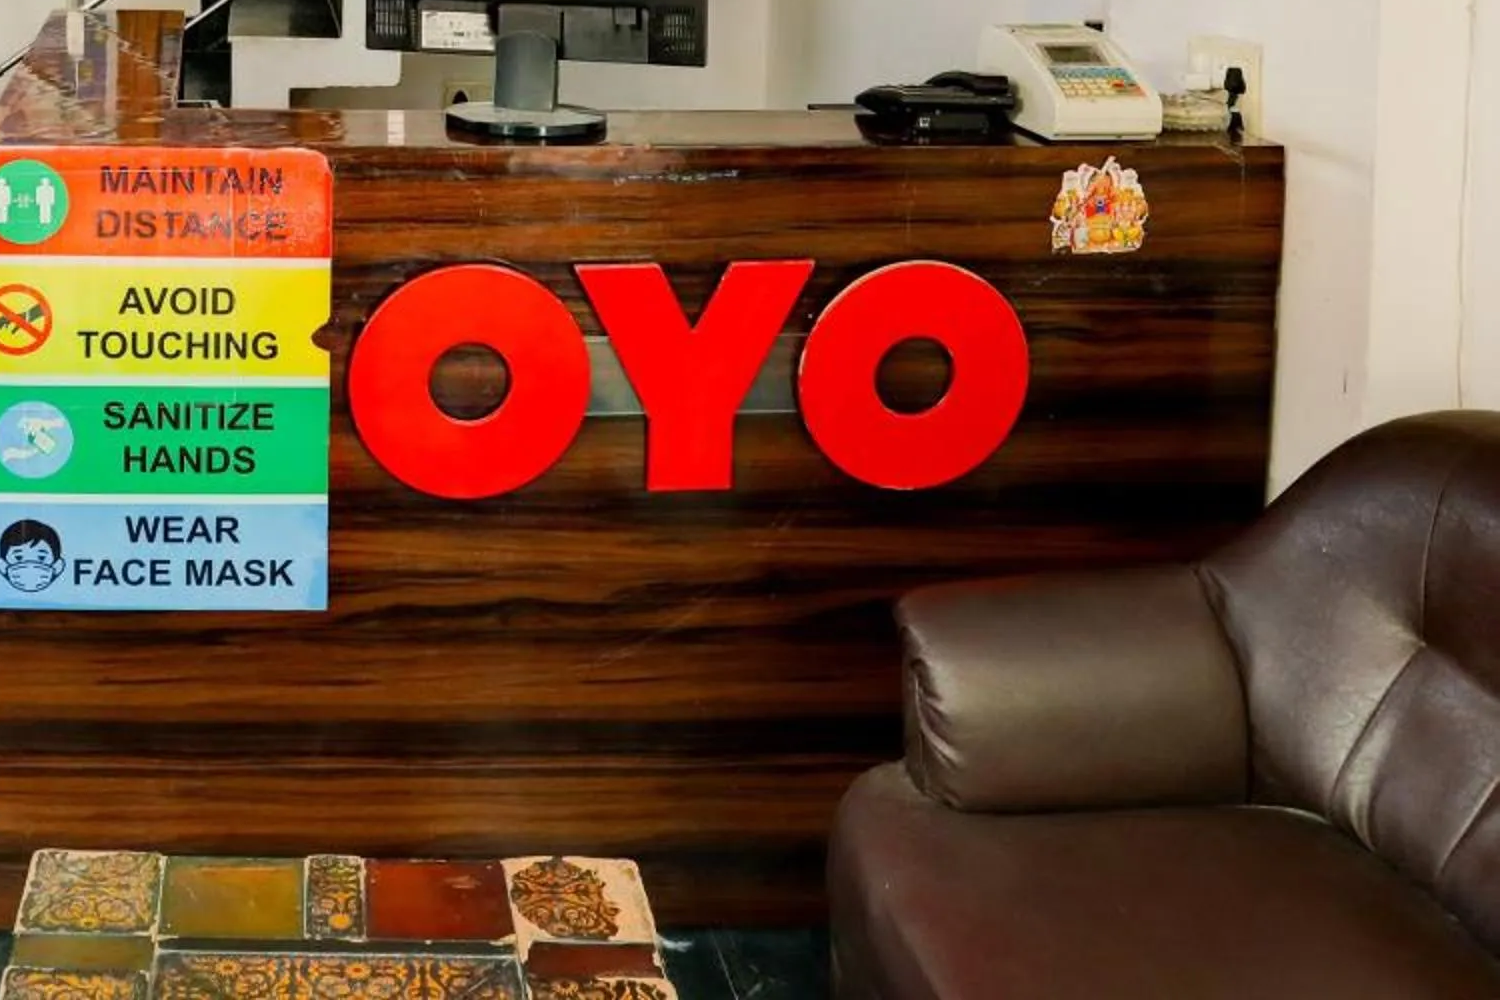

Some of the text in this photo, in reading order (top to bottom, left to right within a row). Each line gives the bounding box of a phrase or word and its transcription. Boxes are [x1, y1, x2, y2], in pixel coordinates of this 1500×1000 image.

[100, 165, 284, 196] MAINTAIN
[96, 210, 288, 242] DISTANCE
[118, 287, 236, 316] AVOID
[77, 331, 279, 361] TOUCHING
[348, 259, 1030, 500] OYO
[103, 401, 275, 431] SANITIZE
[123, 445, 256, 475] HANDS
[125, 515, 240, 544] WEAR
[73, 559, 295, 586] FACE MASK
